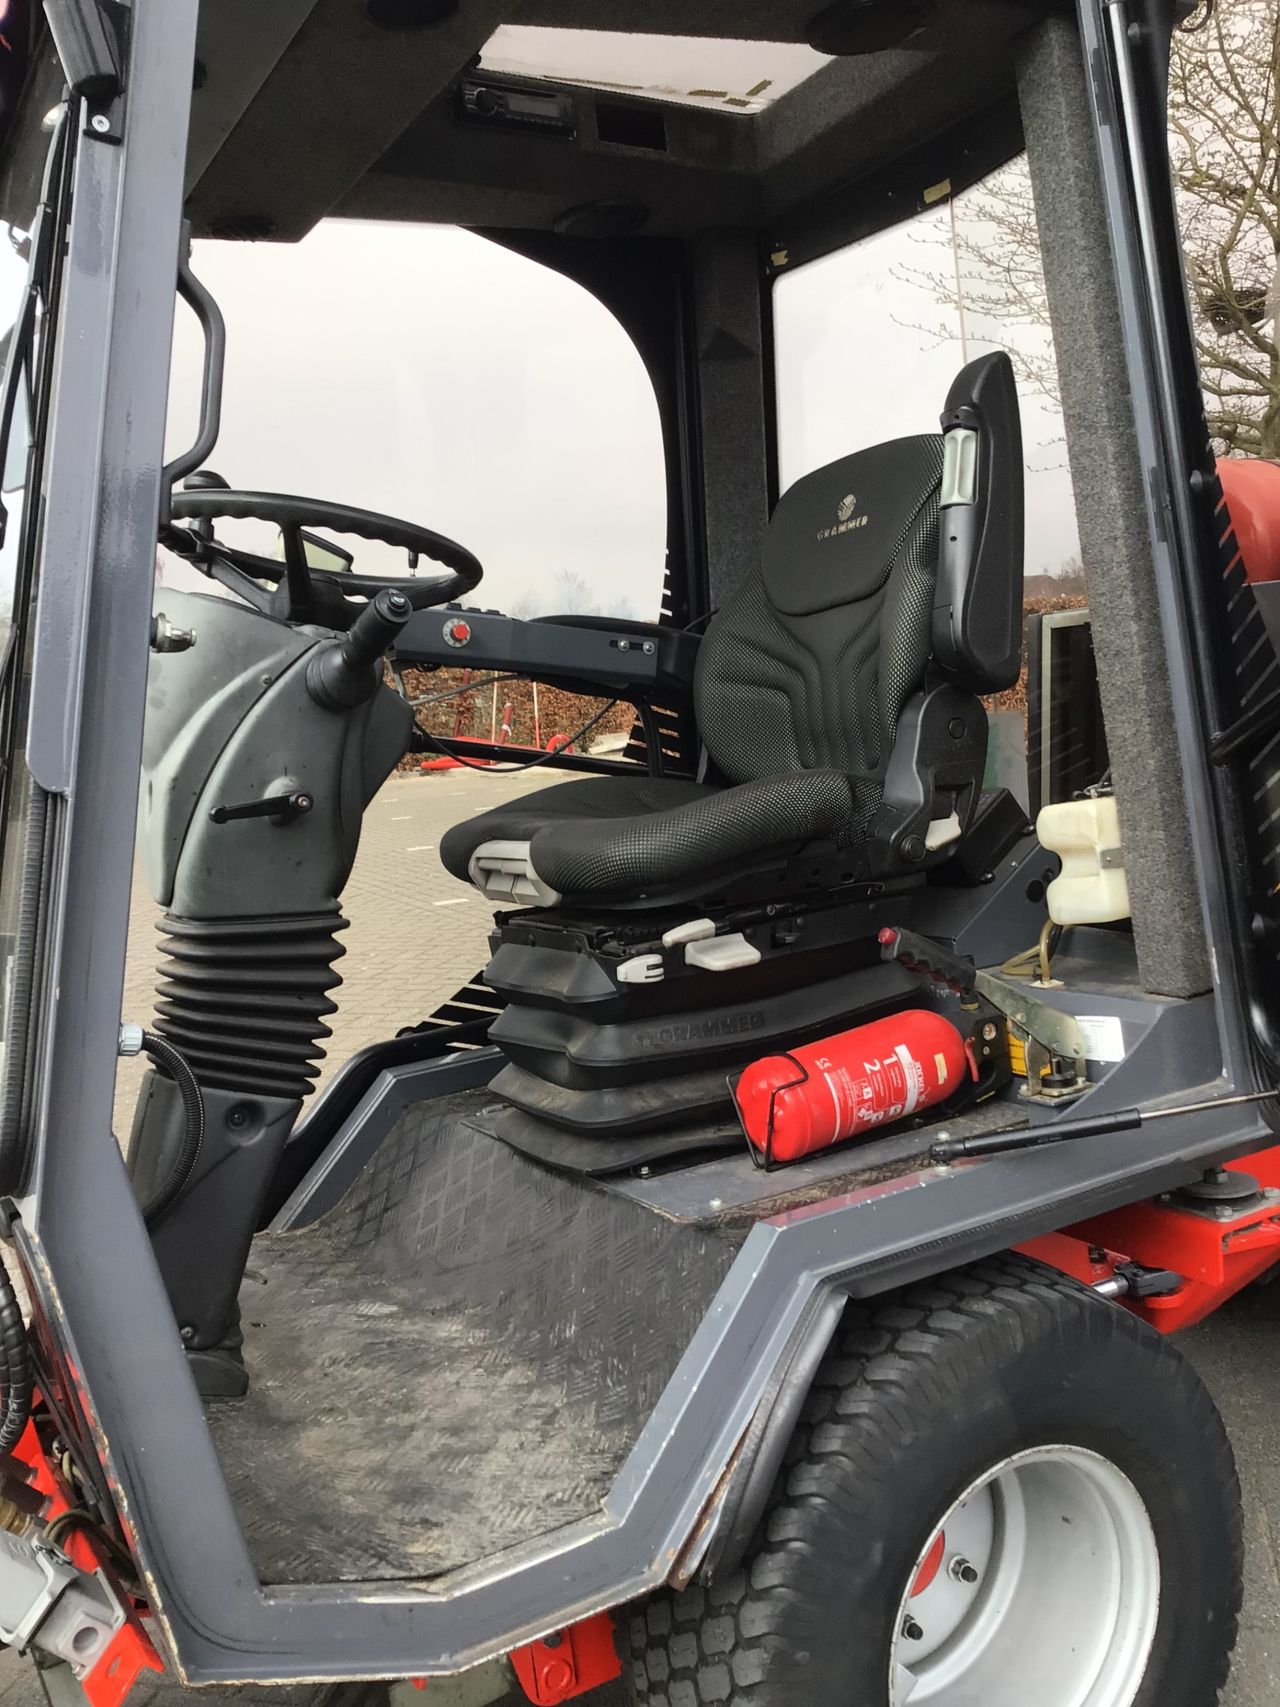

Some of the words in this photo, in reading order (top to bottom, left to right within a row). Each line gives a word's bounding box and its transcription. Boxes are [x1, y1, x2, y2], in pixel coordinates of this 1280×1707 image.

[817, 515, 869, 541] GRAMMER
[660, 1011, 765, 1043] GRAMMER
[863, 1058, 881, 1074] 2
[883, 1053, 898, 1065] 1
